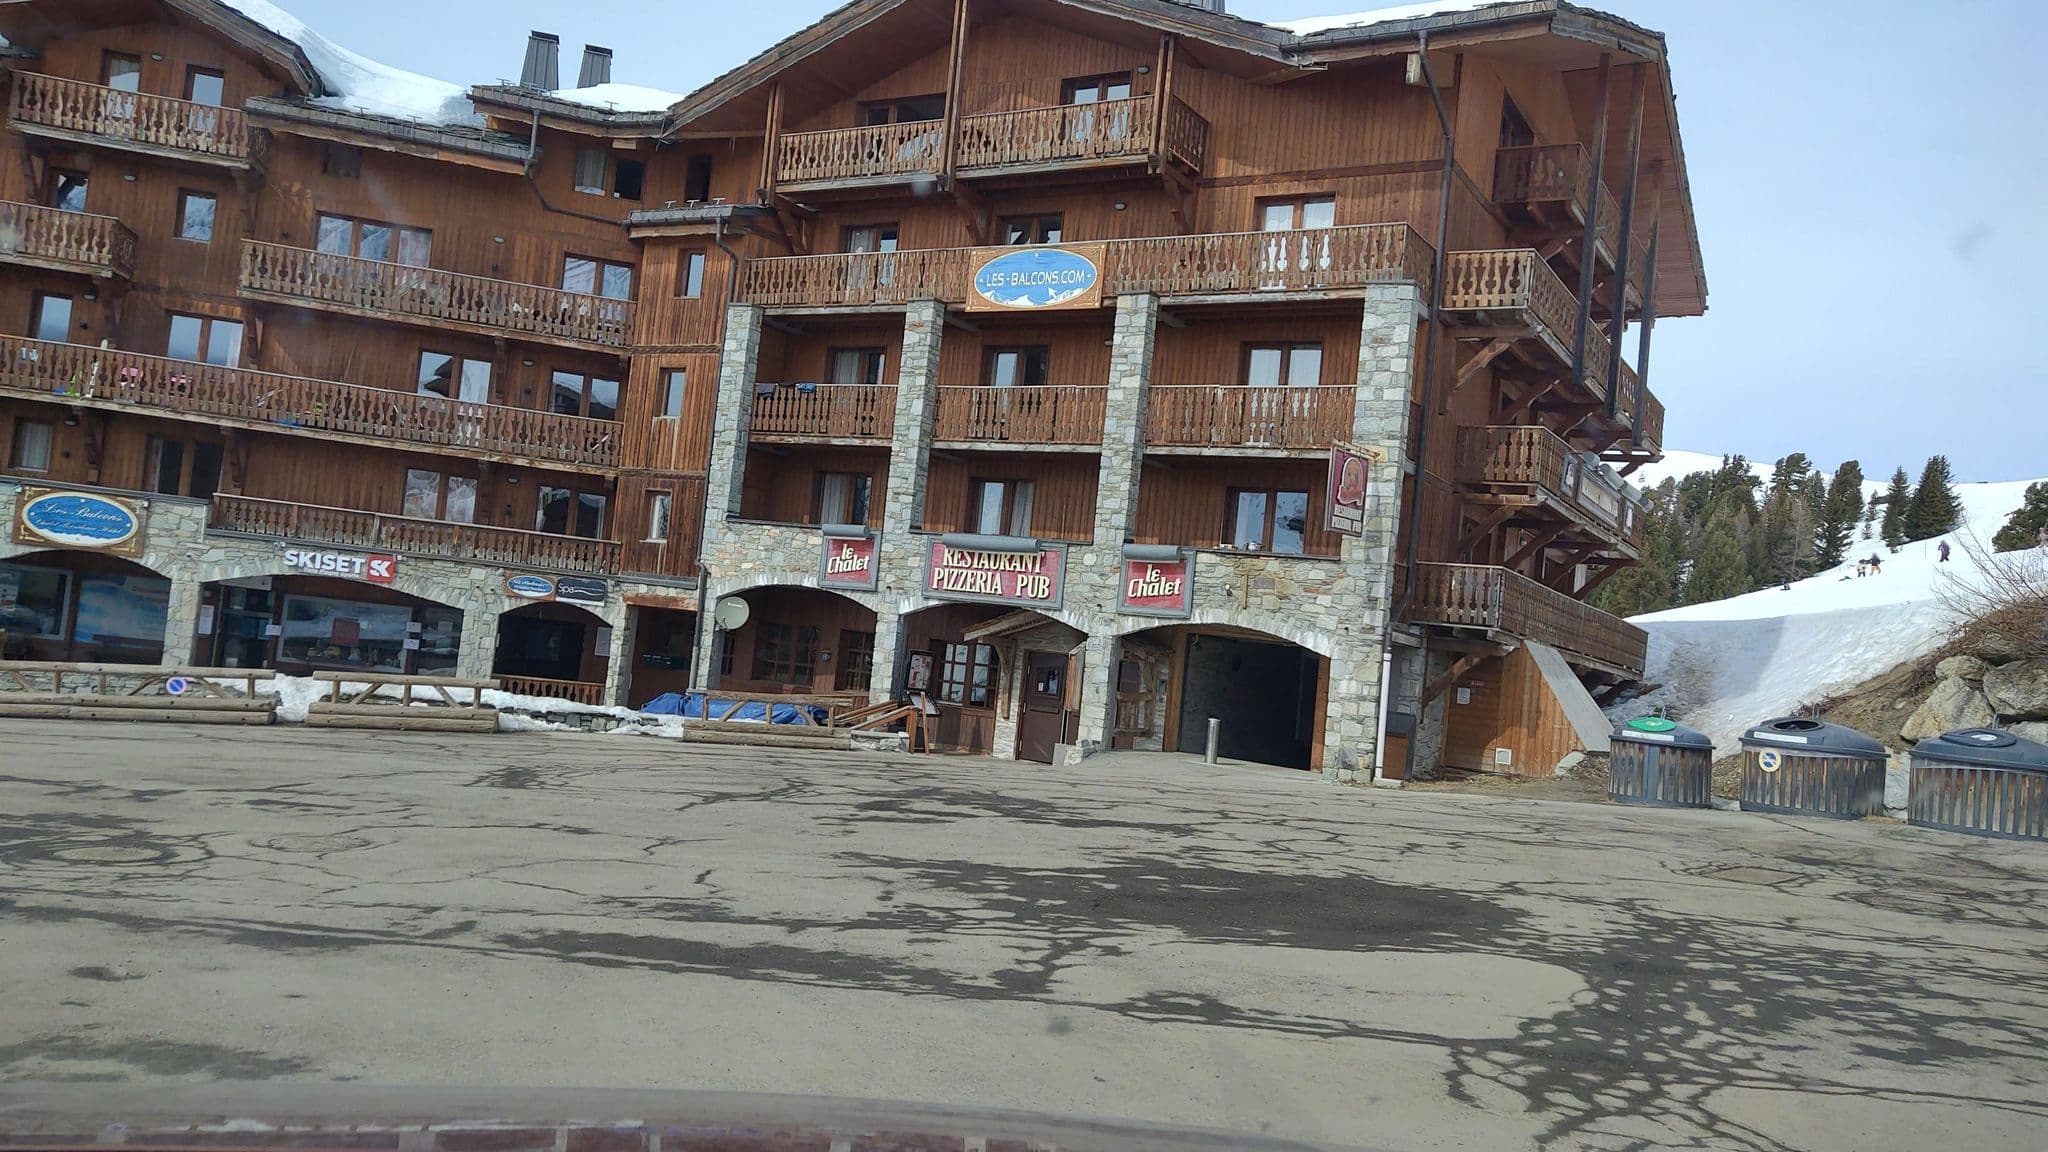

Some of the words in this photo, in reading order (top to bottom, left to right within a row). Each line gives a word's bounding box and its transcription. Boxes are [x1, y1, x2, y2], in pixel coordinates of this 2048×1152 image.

[44, 503, 68, 515] Les
[72, 506, 123, 522] Balcons
[284, 550, 366, 574] SKISET
[827, 554, 870, 574] Chalet
[943, 547, 1046, 574] RESTAURANT
[558, 582, 575, 595] Spa
[932, 567, 1003, 595] PIZZERIA
[1015, 574, 1051, 599] PUB
[1127, 576, 1182, 598] Chalet
